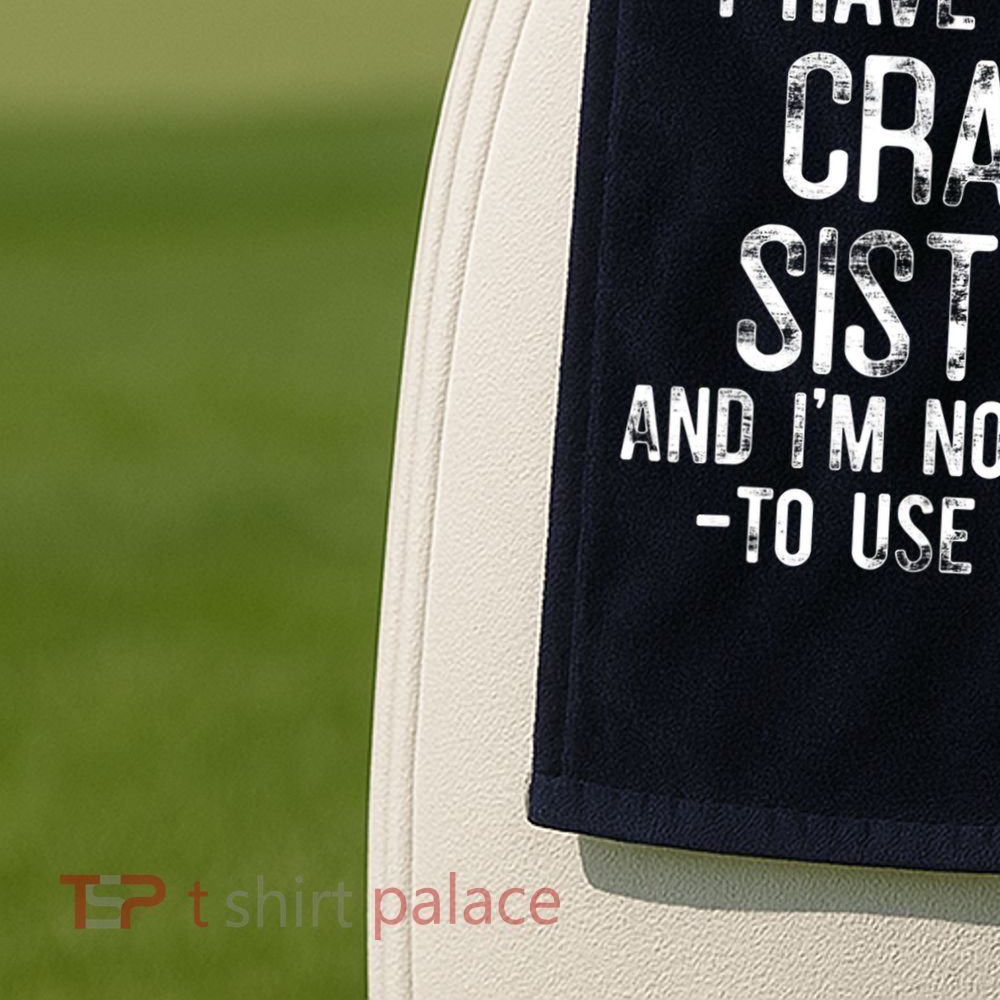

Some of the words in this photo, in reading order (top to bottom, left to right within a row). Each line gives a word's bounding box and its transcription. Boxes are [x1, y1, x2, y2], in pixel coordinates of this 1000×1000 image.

[620, 385, 754, 465] AND
[791, 387, 886, 473] I'M
[852, 492, 975, 575] USE
